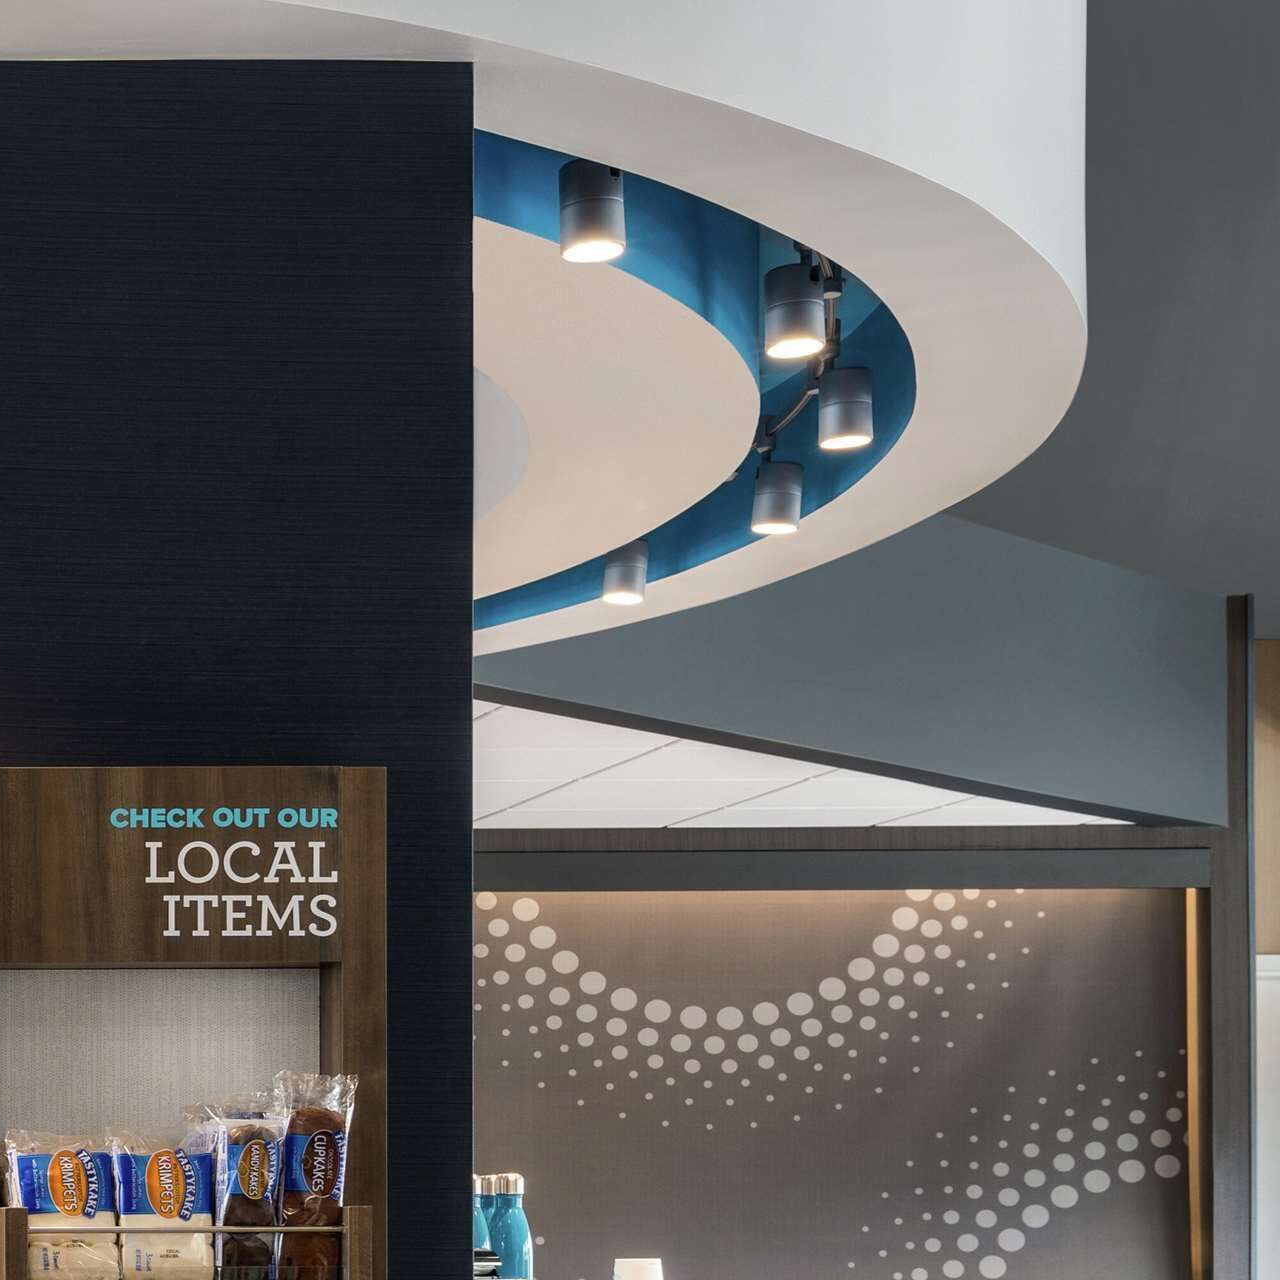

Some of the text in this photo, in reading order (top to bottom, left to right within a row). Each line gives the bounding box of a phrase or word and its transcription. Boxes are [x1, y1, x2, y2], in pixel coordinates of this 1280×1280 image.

[110, 807, 338, 829] CHECK OUT OUR
[144, 840, 339, 884] LOCAL
[162, 894, 338, 937] ITEMS
[58, 1155, 79, 1212] KRIMPETS
[77, 1150, 98, 1218] TASTYKAKE
[157, 1155, 176, 1213] KRIMPETS
[175, 1150, 196, 1220] TASTYKAKE
[248, 1144, 260, 1196] KANDY KAKES
[311, 1135, 327, 1192] CUPKAKES
